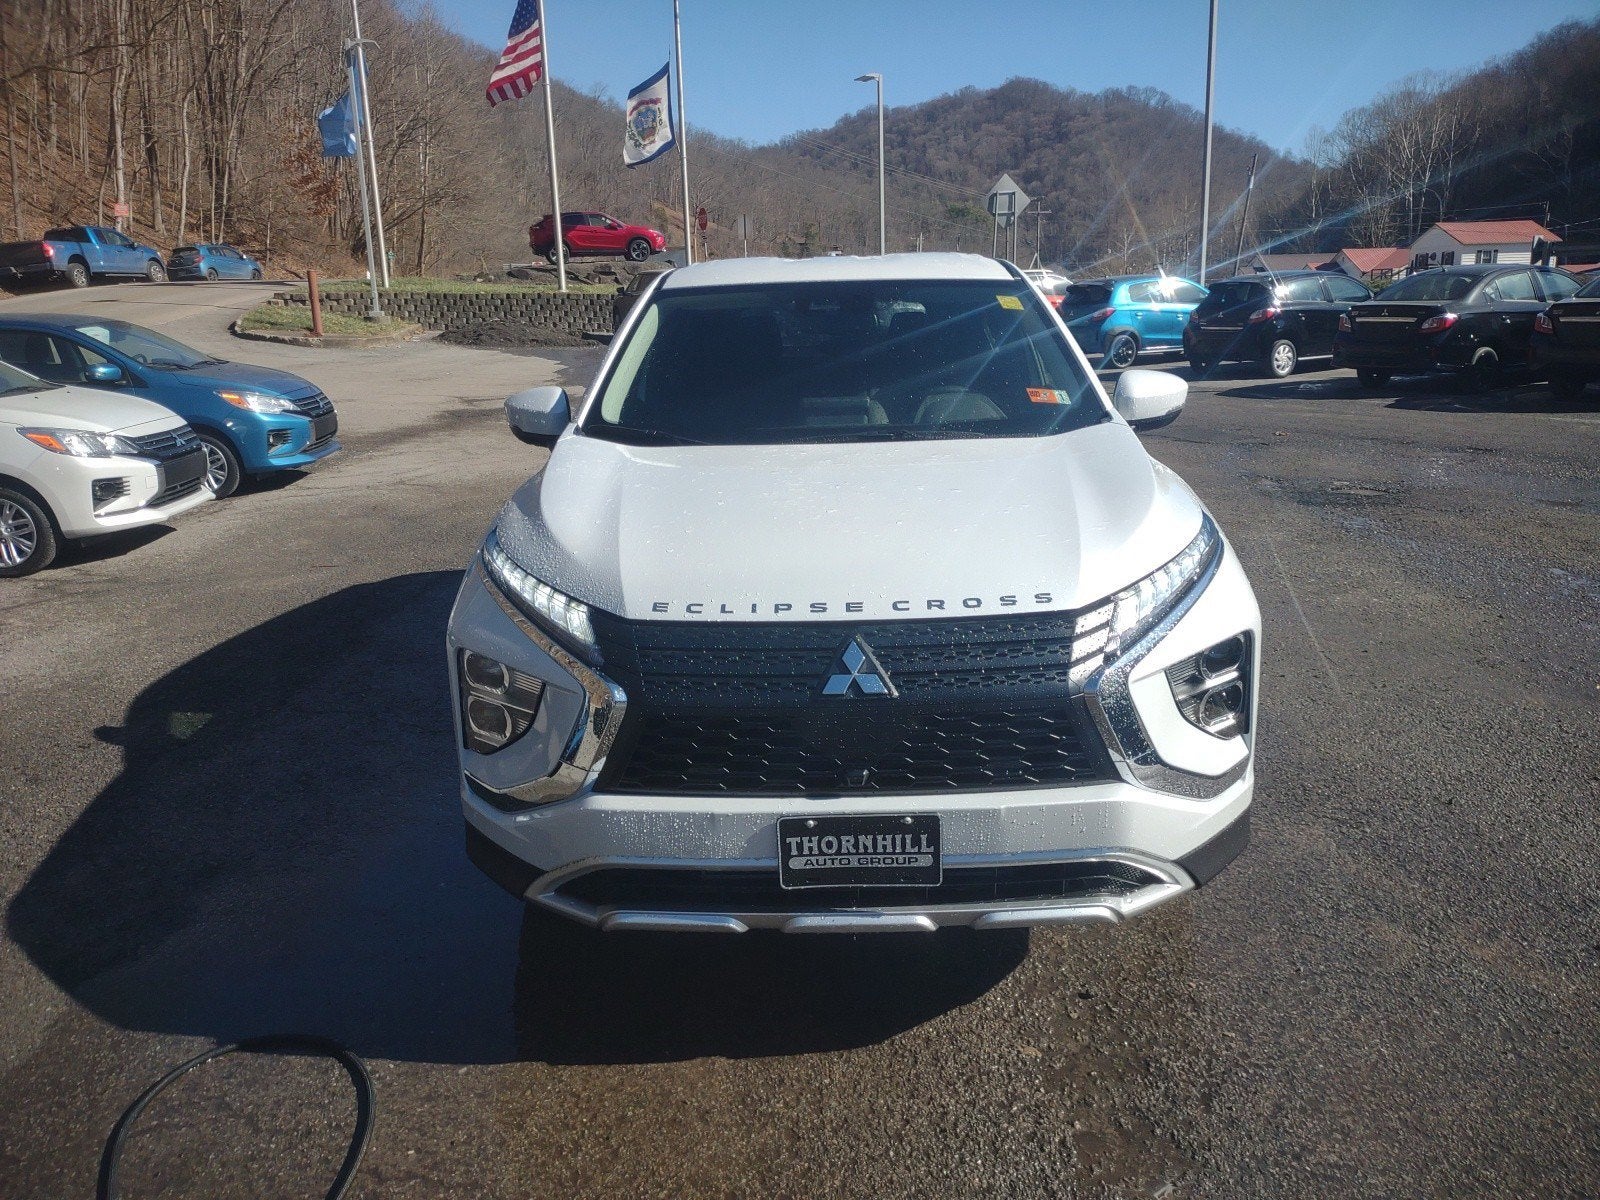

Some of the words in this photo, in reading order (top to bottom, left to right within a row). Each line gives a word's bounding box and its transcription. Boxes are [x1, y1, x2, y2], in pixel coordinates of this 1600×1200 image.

[651, 602, 865, 615] ECLIPSE
[892, 592, 1053, 611] CROSS
[786, 834, 934, 855] THORNHILL
[803, 857, 851, 867] AUTO
[858, 856, 919, 866] GROUP
